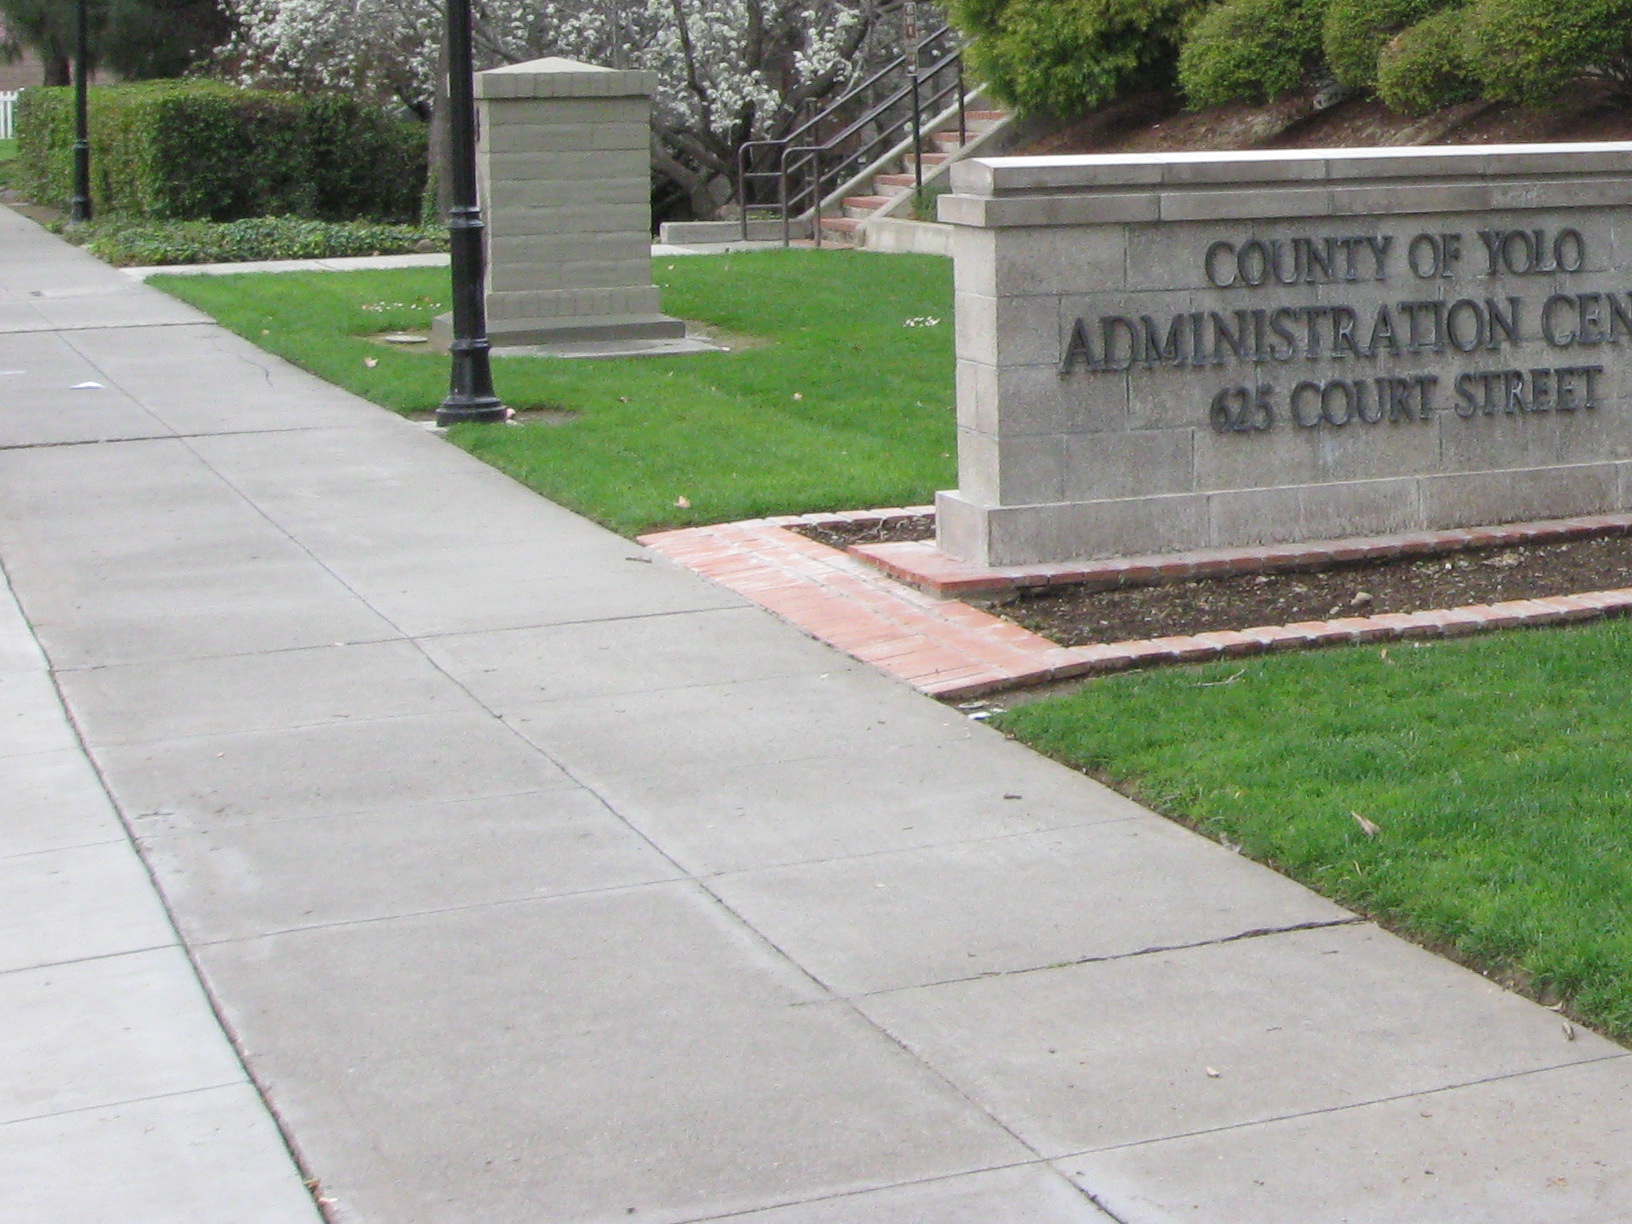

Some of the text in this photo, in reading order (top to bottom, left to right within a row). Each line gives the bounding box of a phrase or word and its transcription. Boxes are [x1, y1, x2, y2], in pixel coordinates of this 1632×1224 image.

[1205, 228, 1585, 288] COUNTY OF YOLO
[1060, 296, 1522, 376] ADMINISTRATION
[1210, 364, 1604, 433] 625 COURT STREET
